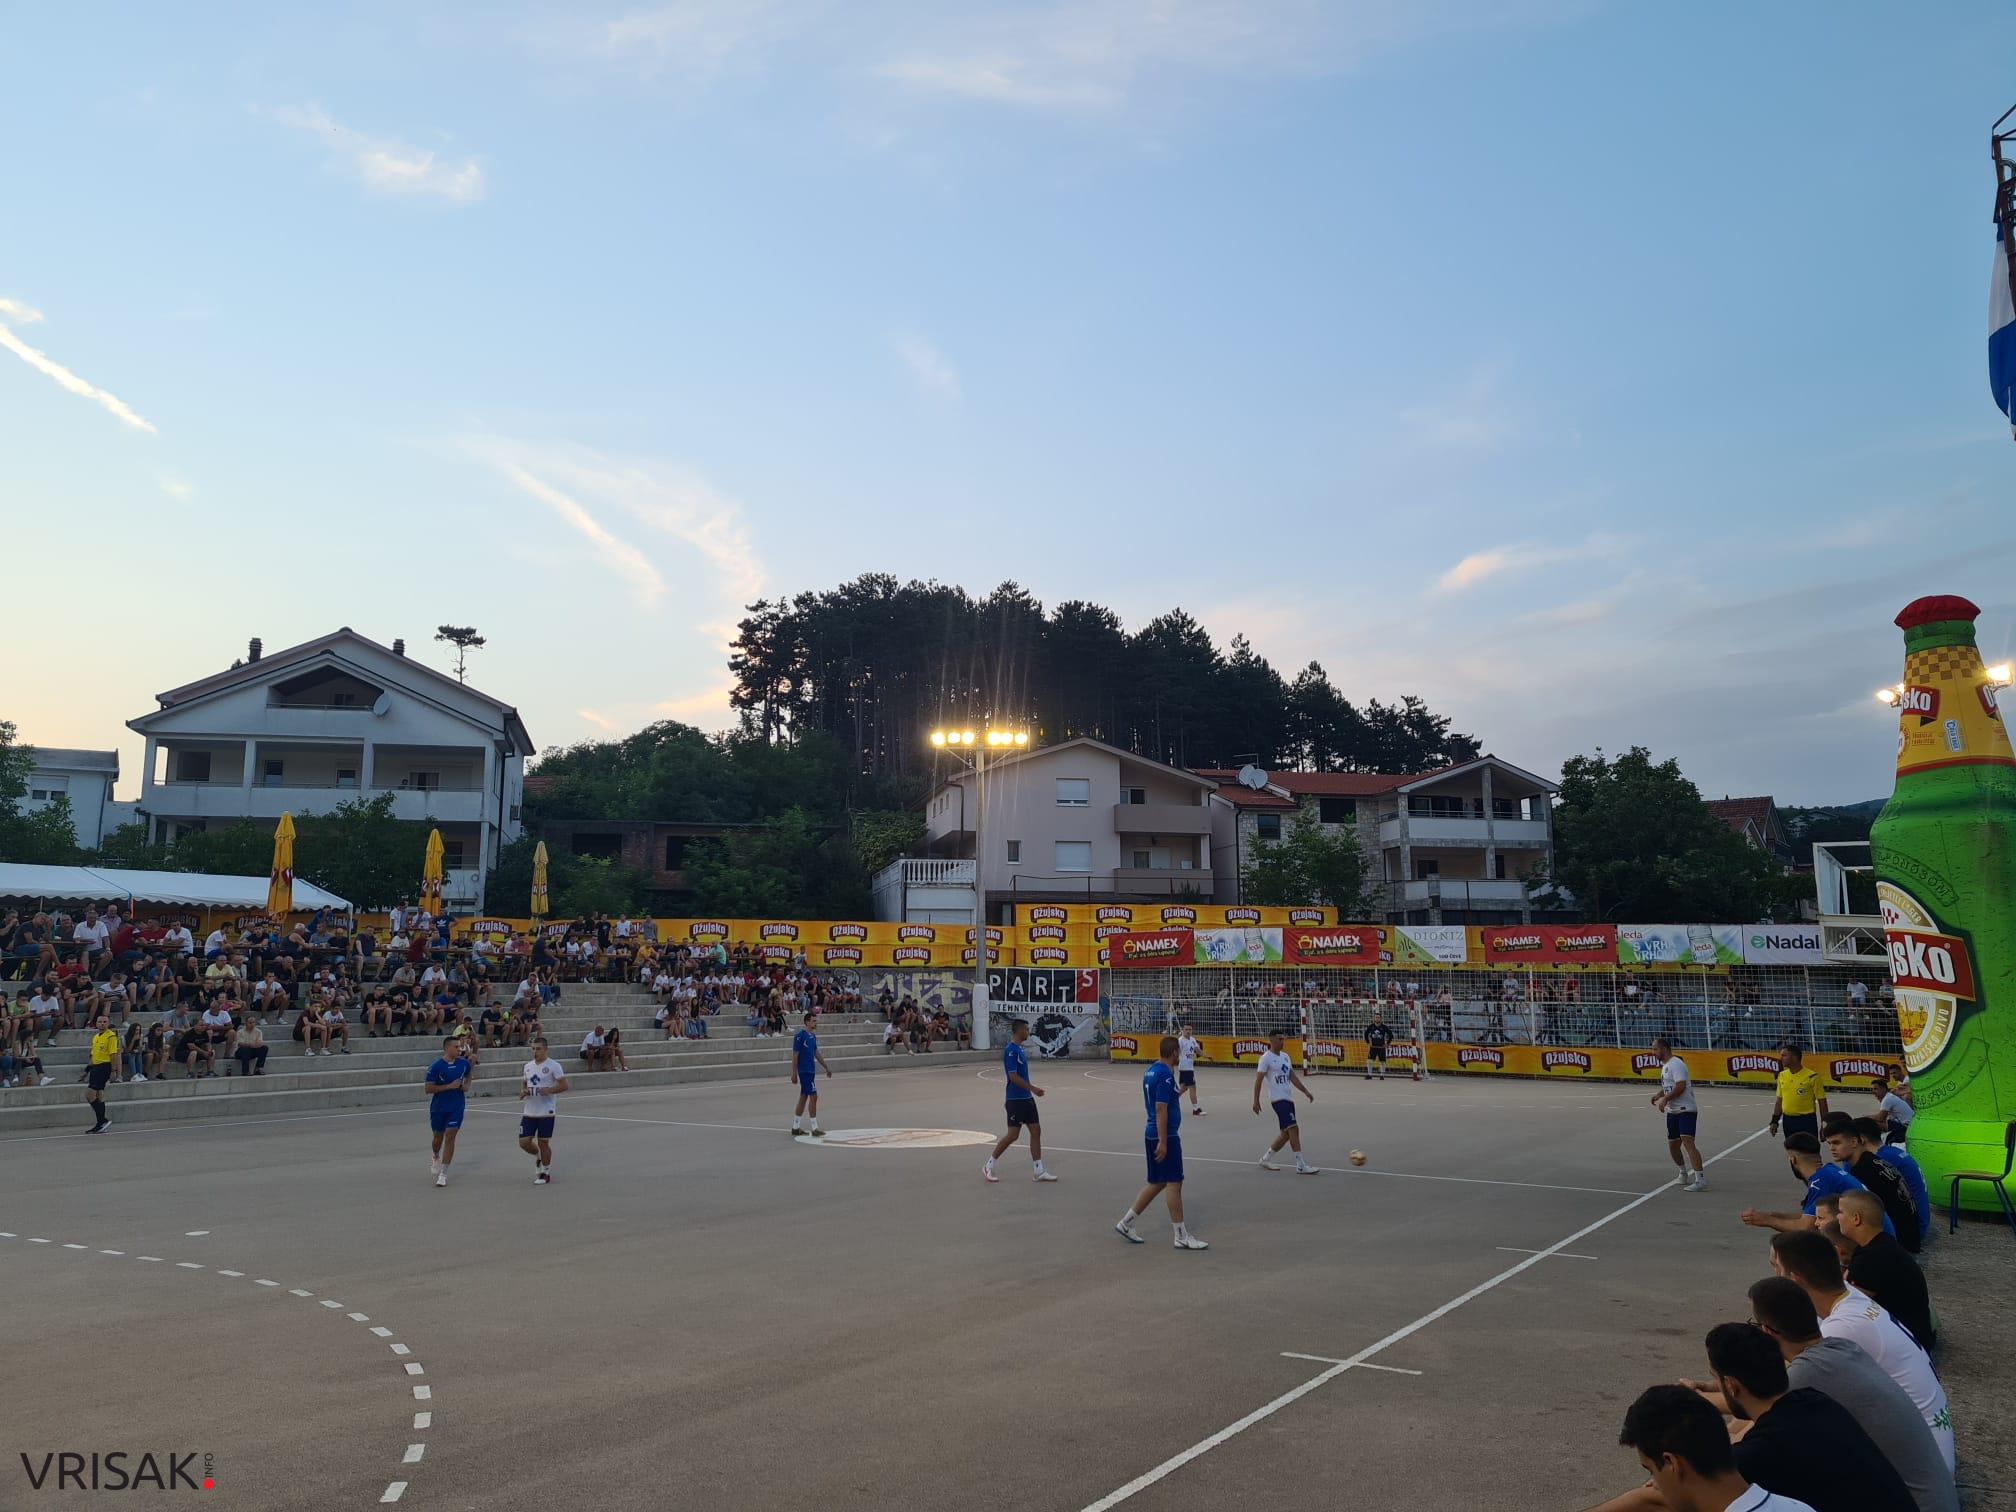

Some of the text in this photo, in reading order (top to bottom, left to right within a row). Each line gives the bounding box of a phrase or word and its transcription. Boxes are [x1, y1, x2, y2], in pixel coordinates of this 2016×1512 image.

[1033, 907, 1065, 919] Ožujsko
[1099, 908, 1130, 919] Ožujsko
[1163, 907, 1194, 919] Ožujsko
[1228, 909, 1258, 920] Ožujsko
[1291, 910, 1322, 922] Ožujsko
[832, 924, 865, 936] Ožujsko
[901, 926, 933, 938] Ožujsko
[1032, 926, 1063, 938] Ožujsko
[1136, 938, 1179, 951] NAMEX
[1313, 936, 1360, 949] NAMEX
[1504, 936, 1541, 946] NAMEX
[1567, 936, 1606, 946] NAMEX
[1766, 935, 1820, 949] Nadal
[897, 947, 928, 959] Ožujsko
[1034, 948, 1065, 959] Ožujsko
[1886, 934, 1956, 984] jsko
[989, 969, 1093, 1003] PARTS
[998, 1003, 1083, 1013] TEHNIČKI PREGLED
[1110, 1036, 1135, 1050] žujsko
[1461, 1049, 1500, 1063] Ožujsko
[1546, 1051, 1587, 1066] Ožujsko
[1732, 1055, 1780, 1071] Ožujsko
[1835, 1059, 1886, 1076] Ožujsko
